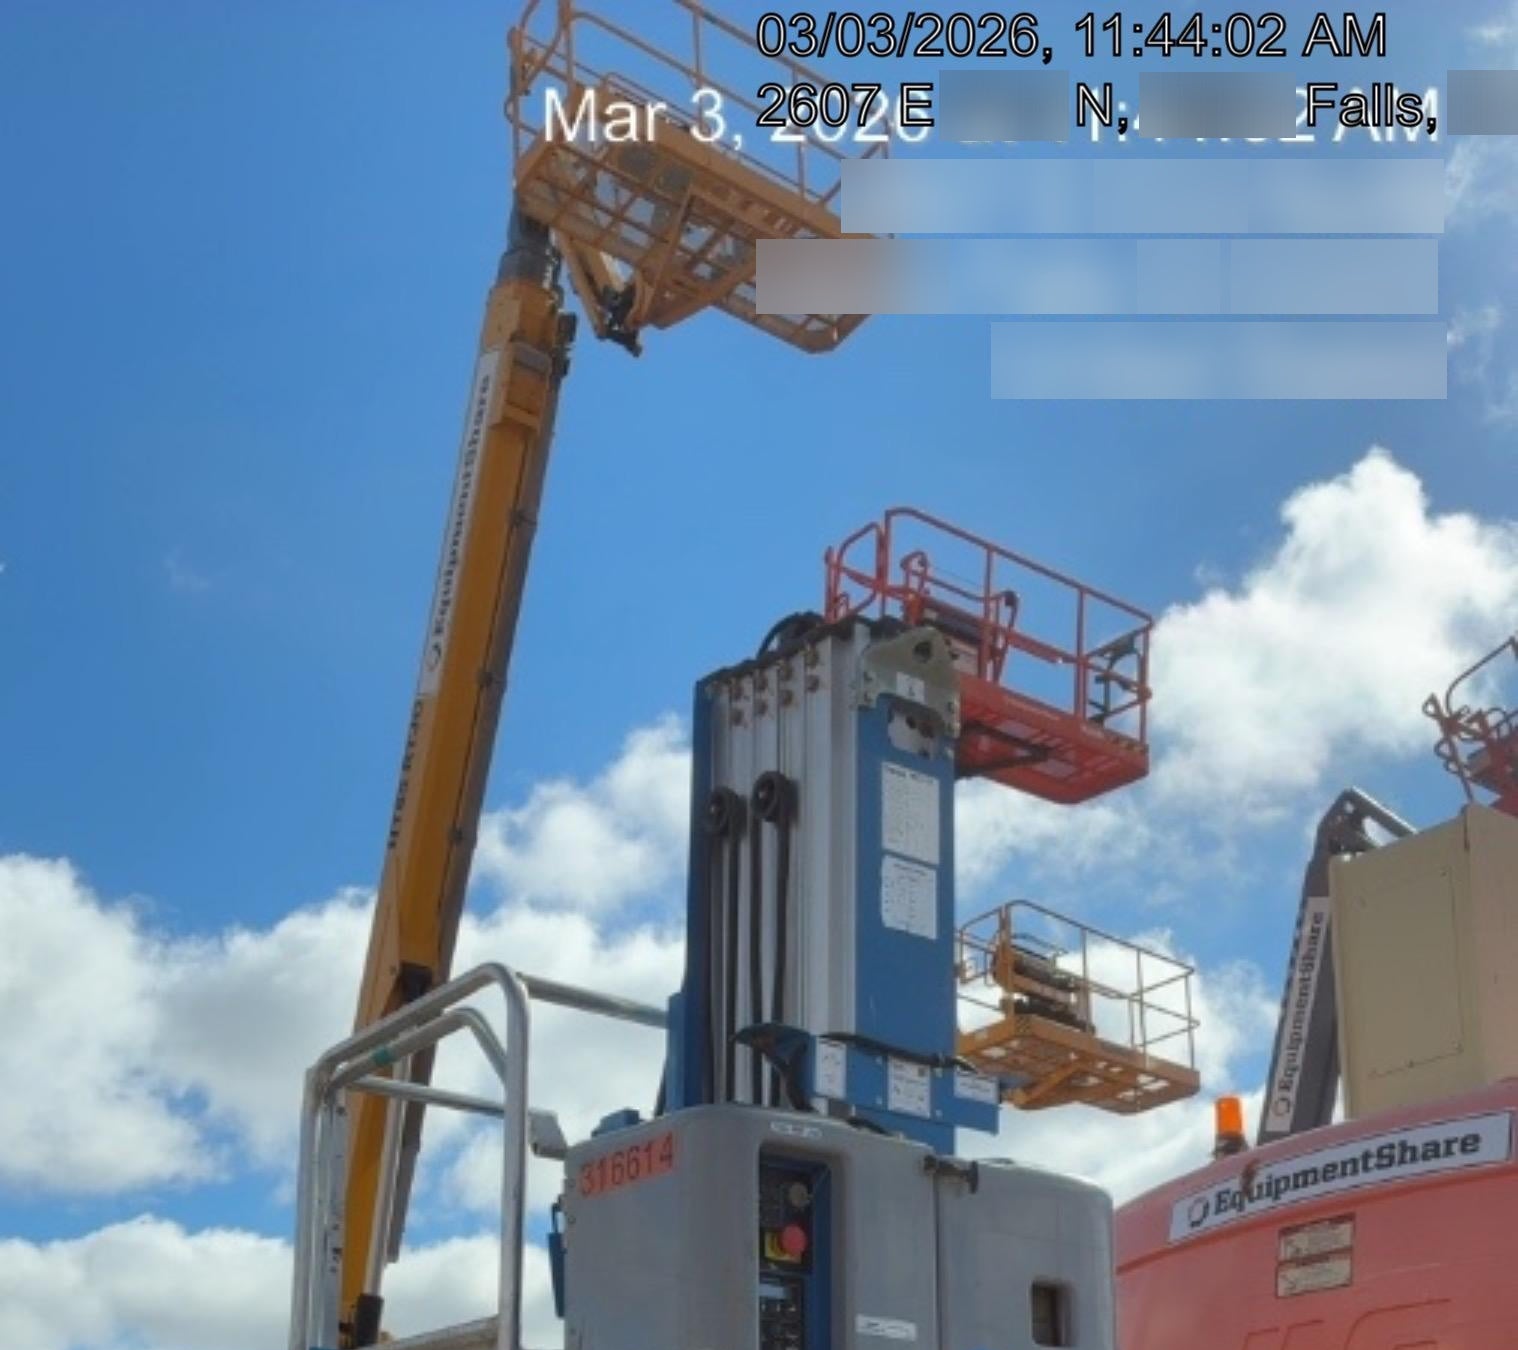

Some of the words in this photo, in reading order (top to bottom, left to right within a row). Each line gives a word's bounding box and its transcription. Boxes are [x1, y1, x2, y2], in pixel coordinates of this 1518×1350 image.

[1277, 911, 1325, 1092] EquipmentShare
[582, 1130, 674, 1198] 316614
[1213, 1132, 1482, 1216] EquipmentShare
